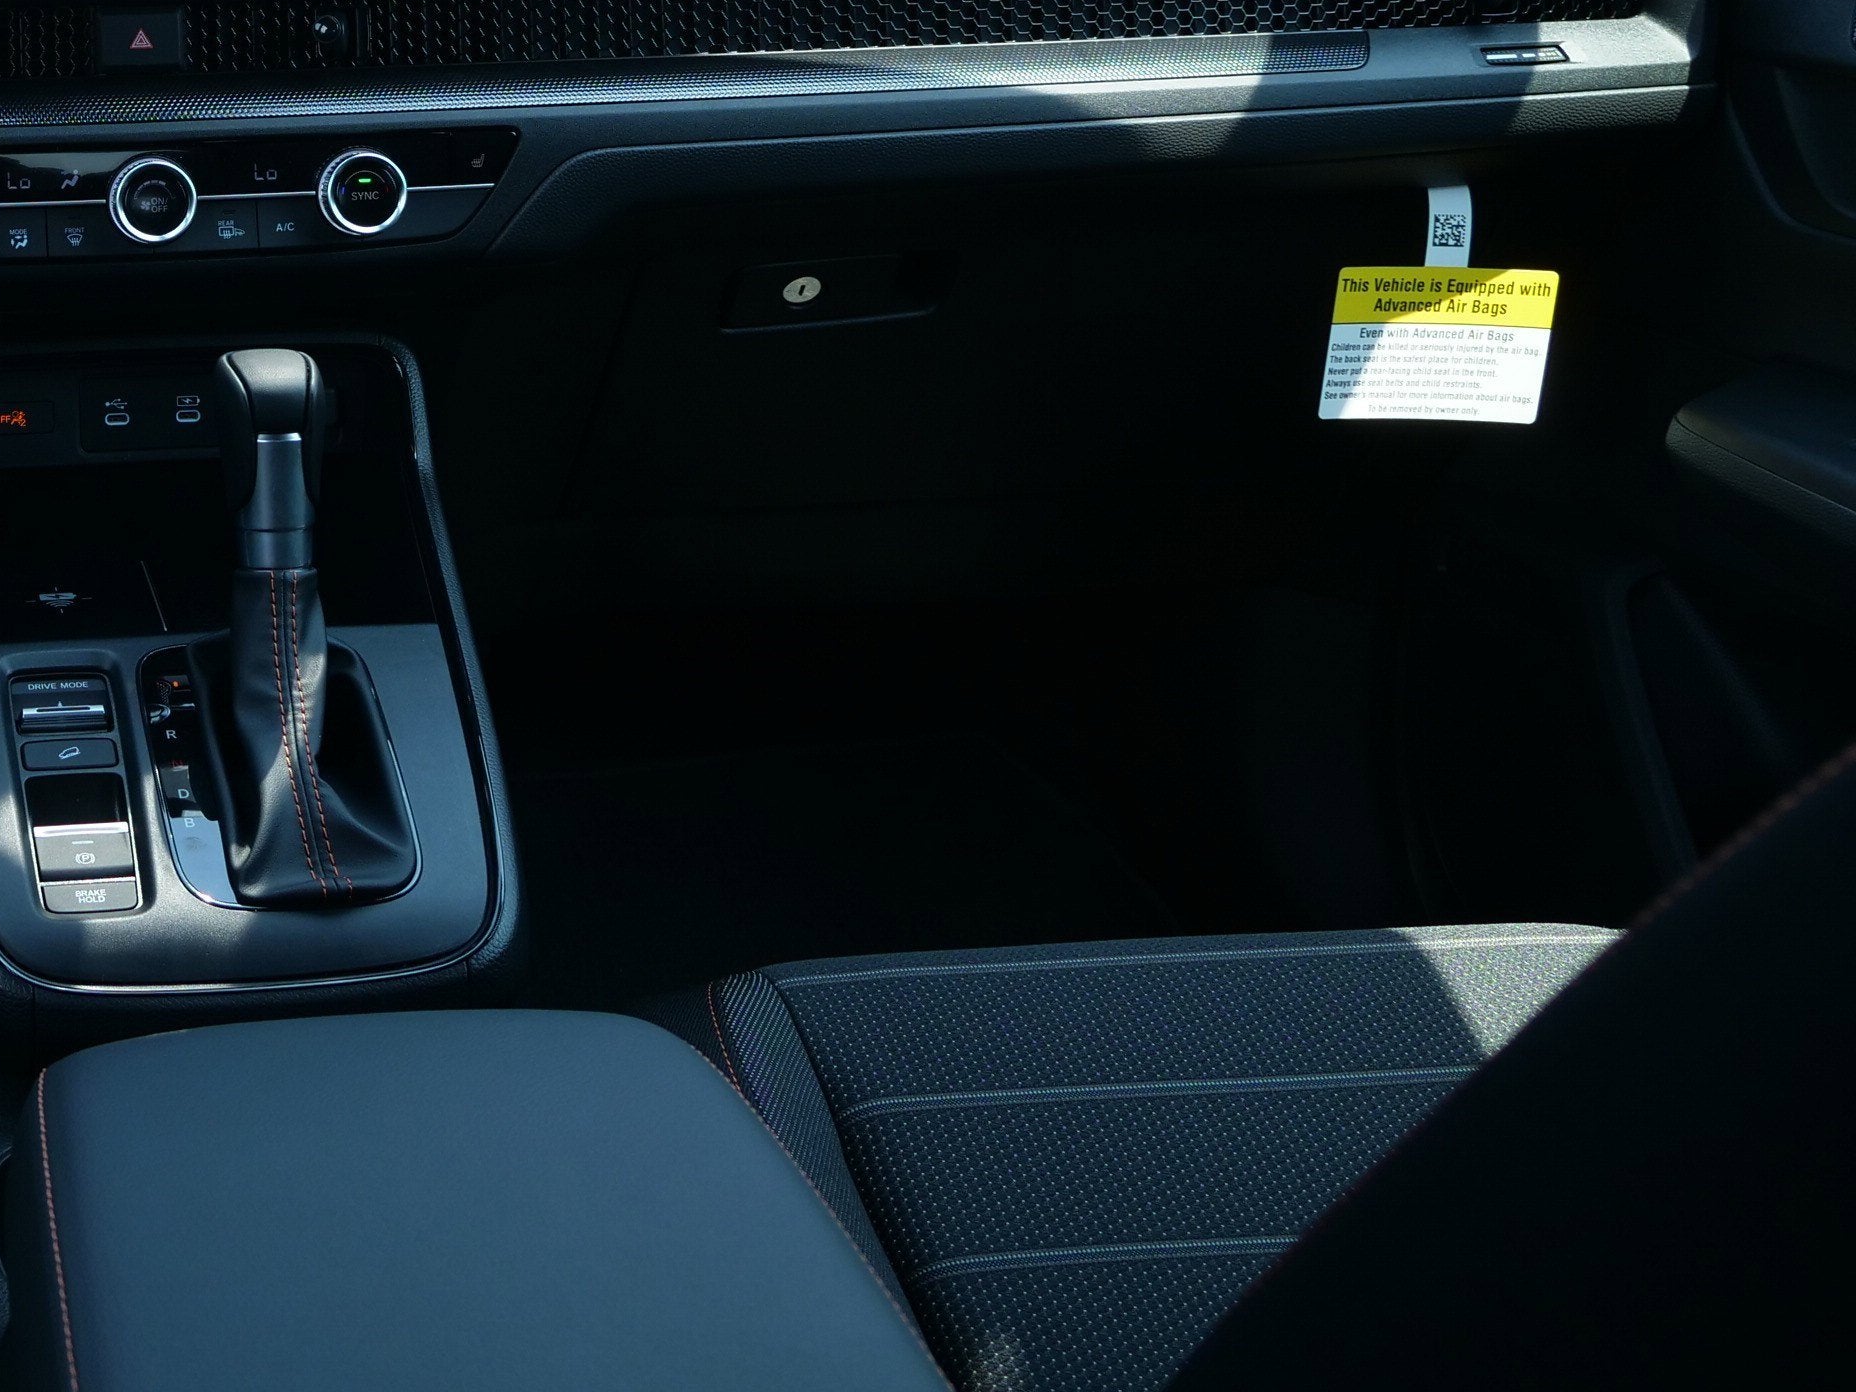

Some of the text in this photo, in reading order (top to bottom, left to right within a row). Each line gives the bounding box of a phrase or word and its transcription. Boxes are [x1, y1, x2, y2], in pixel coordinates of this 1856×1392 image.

[351, 190, 380, 200] SYNC
[276, 222, 295, 232] A/C
[1342, 278, 1551, 297] This Vehicle is Equipped with
[1373, 298, 1508, 318] Advanced Air Bags
[1360, 327, 1515, 342] Even with Advanced Air Bags
[1331, 343, 1361, 351] Children
[1420, 344, 1454, 352] seriously
[1456, 344, 1484, 353] injured
[1486, 346, 1494, 354] by
[1496, 346, 1509, 354] the
[1511, 346, 1522, 354] air
[1524, 347, 1542, 357] bag.
[1330, 355, 1342, 363] The
[1344, 355, 1362, 363] back
[1428, 356, 1449, 364] place
[1451, 356, 1462, 364] for
[1464, 356, 1500, 366] children.
[1350, 368, 1362, 376] put
[1434, 368, 1450, 376] seat
[1452, 368, 1460, 376] in
[1462, 368, 1474, 376] the
[1476, 369, 1498, 378] front.
[1326, 380, 1351, 388] Always
[1422, 380, 1440, 388] child
[1442, 380, 1482, 389] restraints.
[1324, 391, 1338, 400] See
[1339, 391, 1366, 399] owner's
[1398, 391, 1408, 399] for
[1430, 392, 1474, 400] information
[1476, 393, 1498, 402] about
[1500, 394, 1510, 402] air
[1512, 394, 1533, 405] bags.
[1368, 404, 1480, 416] To be removed by owner only.
[28, 681, 88, 690] DRIVE MODE
[166, 730, 177, 740] R
[178, 788, 189, 799] D
[184, 818, 196, 828] B
[75, 888, 106, 898] BRAKE
[78, 896, 106, 904] HOLD
